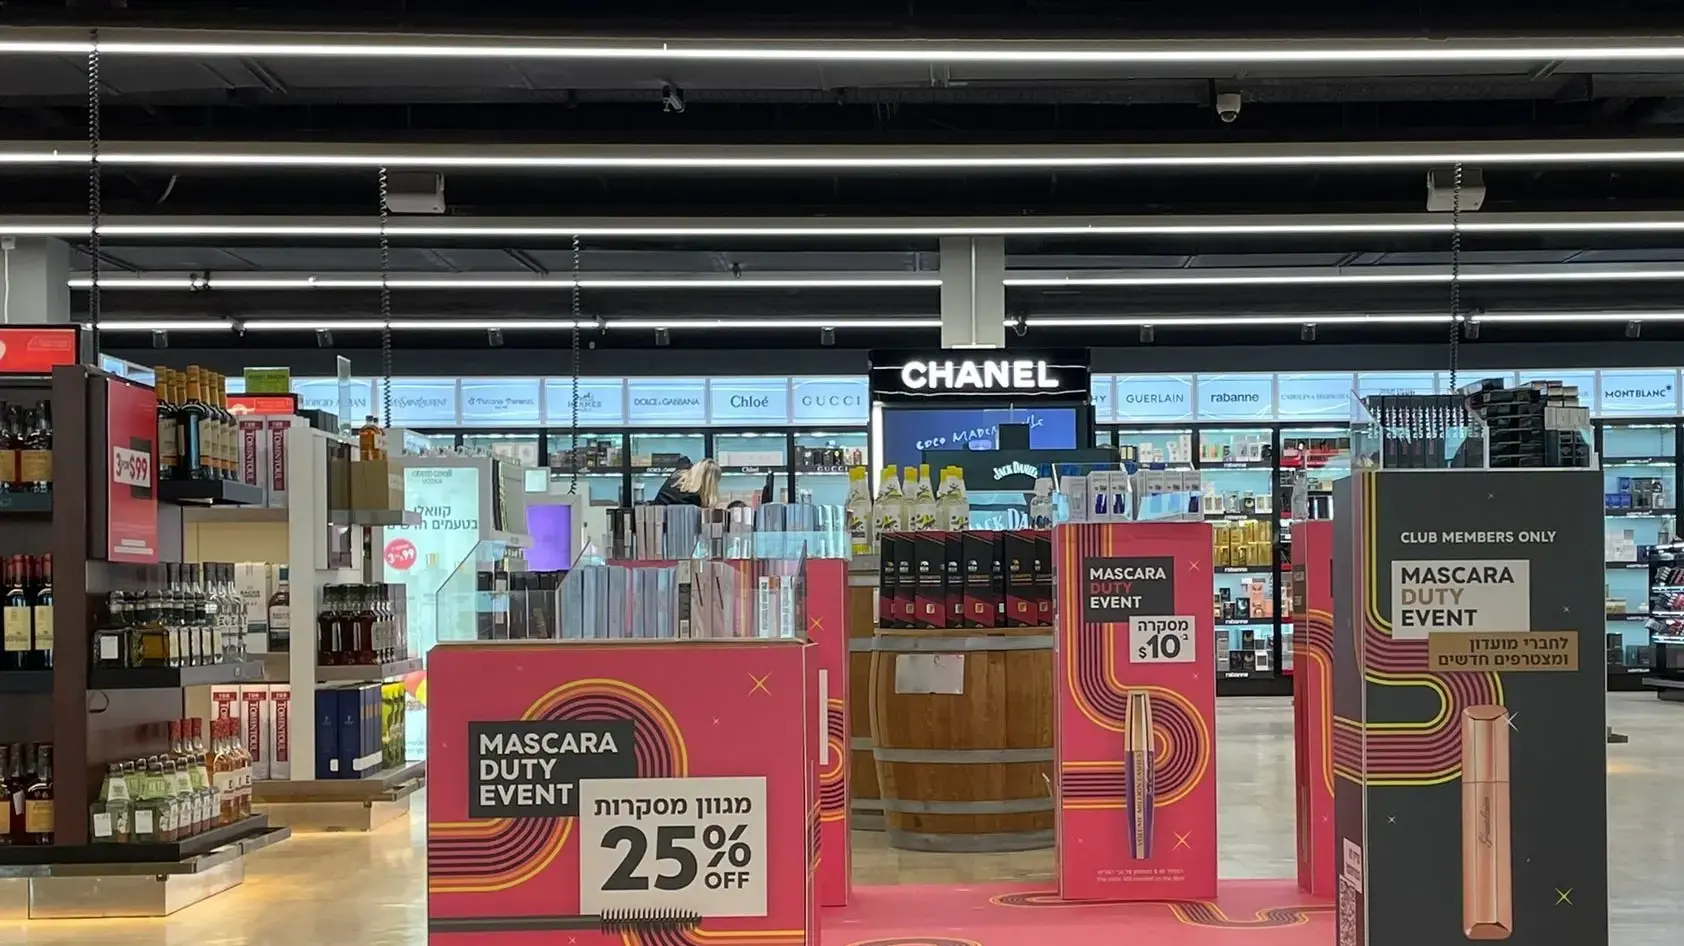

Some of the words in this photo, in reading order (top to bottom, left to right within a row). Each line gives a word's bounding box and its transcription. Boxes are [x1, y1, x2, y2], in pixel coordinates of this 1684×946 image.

[901, 360, 1060, 389] CHANEL
[730, 394, 769, 408] Chloé
[802, 395, 861, 407] GUCCI
[1126, 393, 1184, 403] GUERLAIN
[1210, 392, 1259, 403] rabanne
[1605, 389, 1666, 399] MONTBLANC
[993, 465, 1014, 480] JACK
[432, 519, 478, 530] בטעמים
[1400, 531, 1438, 544] CLUB
[1442, 531, 1515, 544] MEMBERS
[1518, 531, 1557, 543] ONLY
[1089, 567, 1166, 580] MASCARA
[1401, 566, 1515, 584] MASCARA
[1090, 582, 1133, 594] DUTY
[1090, 596, 1142, 609] EVENT
[1401, 588, 1465, 606] DUTY
[1401, 609, 1478, 627] EVENT
[1138, 620, 1189, 634] מסקרה
[1469, 638, 1518, 652] מועדון
[1524, 637, 1568, 650] לחברי
[1438, 653, 1489, 667] חדשים
[1494, 653, 1569, 667] ומצטרפים
[479, 731, 619, 755] MASCARA
[479, 758, 558, 780] DUTY
[479, 783, 574, 806] EVENT
[594, 797, 688, 820] מסקרות
[697, 797, 752, 820] מגוון
[600, 824, 752, 891] 25%
[704, 871, 750, 890] OFF
